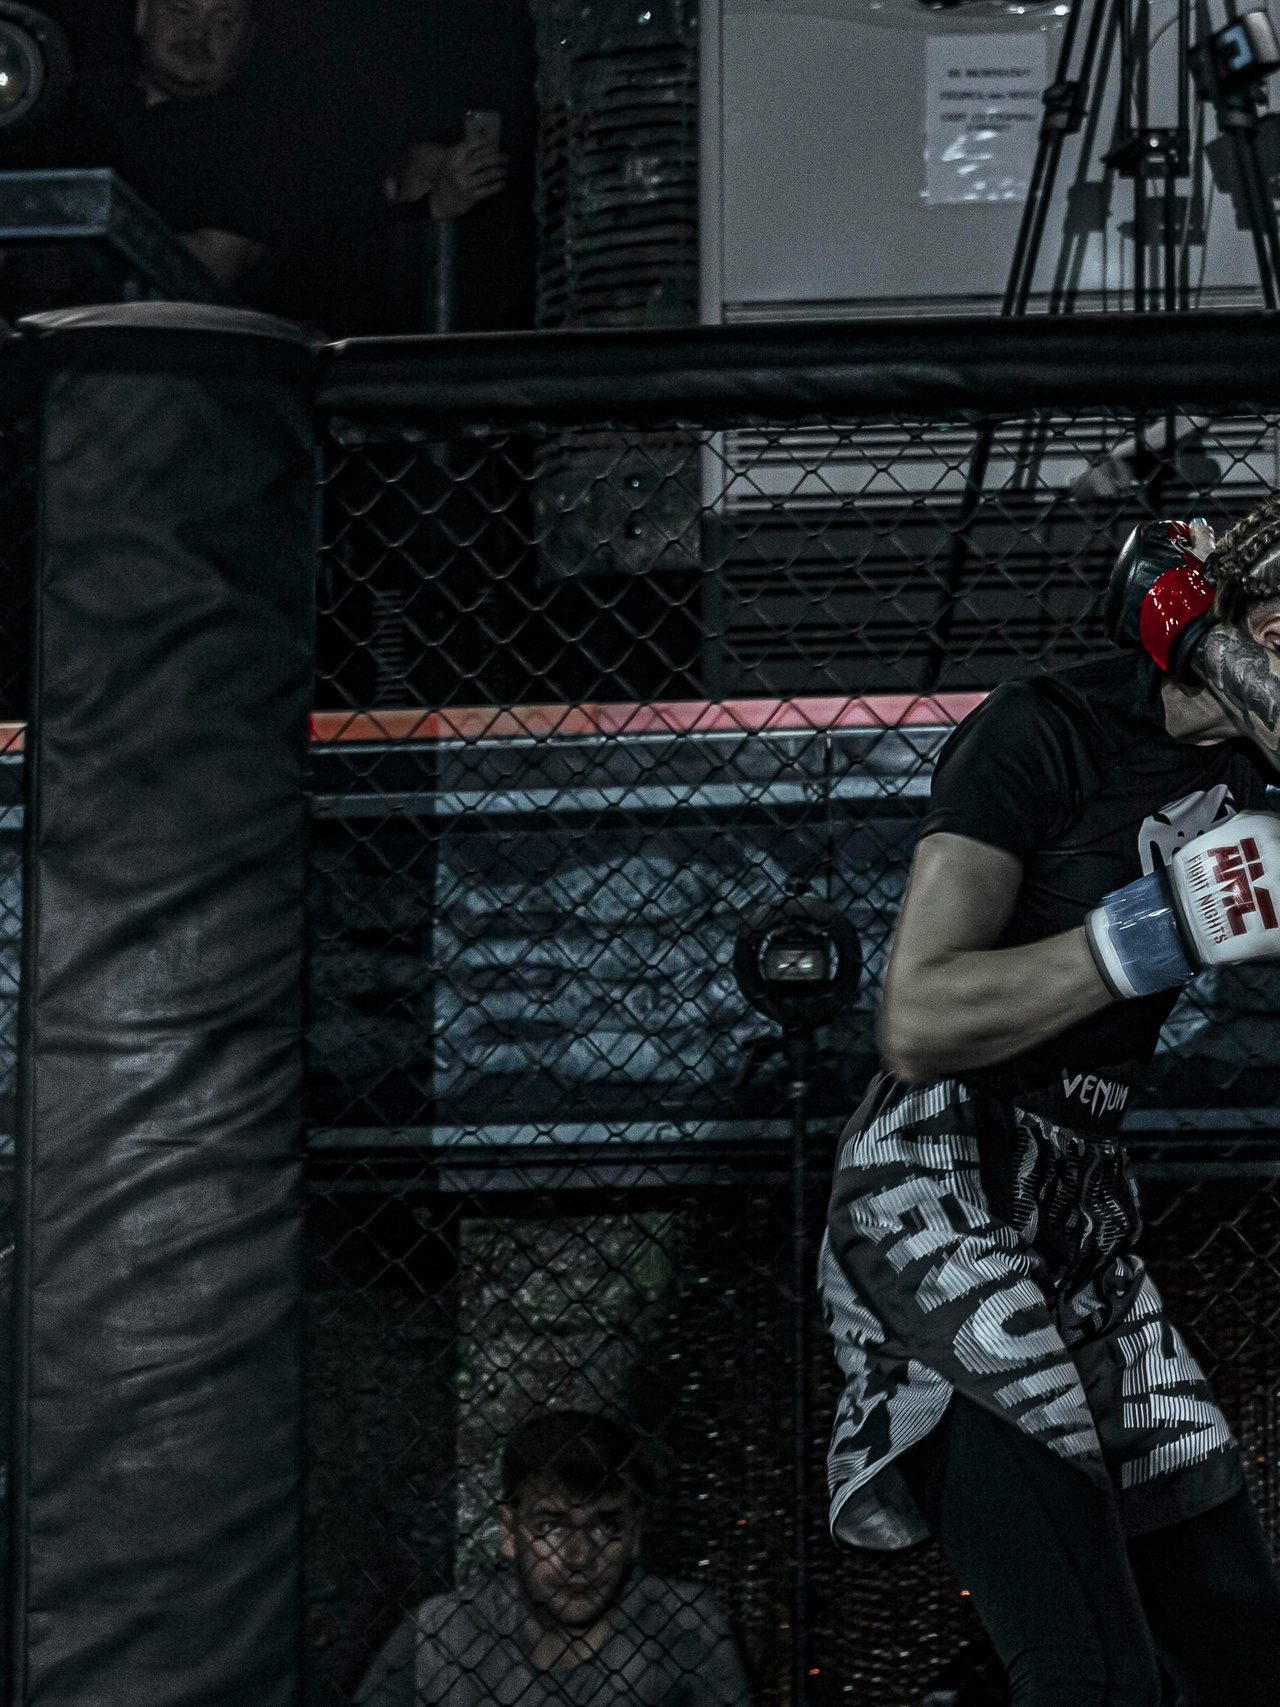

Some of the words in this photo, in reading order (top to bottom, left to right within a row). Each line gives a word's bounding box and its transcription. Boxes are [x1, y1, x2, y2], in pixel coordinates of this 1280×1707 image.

[1184, 853, 1210, 894] FIGHT
[1196, 893, 1229, 944] NIGHTS
[1061, 1070, 1130, 1118] VENUM
